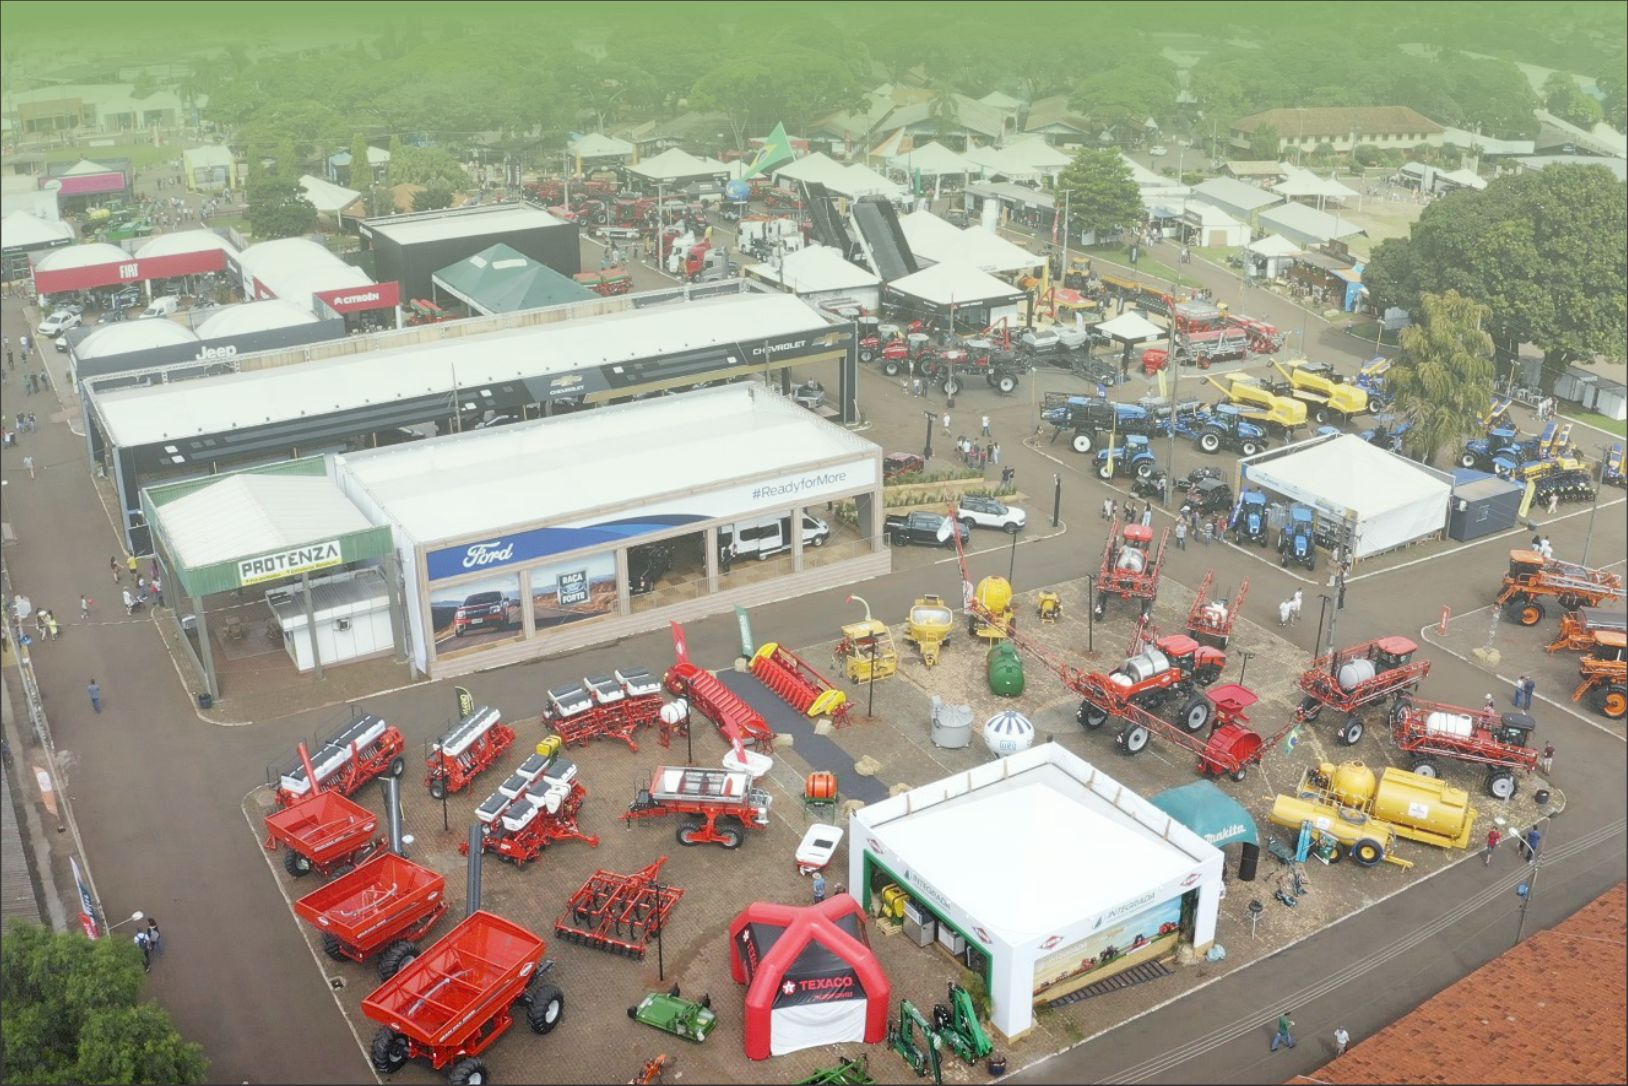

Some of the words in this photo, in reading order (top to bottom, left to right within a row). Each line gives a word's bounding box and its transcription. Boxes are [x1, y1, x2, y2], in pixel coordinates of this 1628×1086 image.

[119, 262, 138, 279] FIAT
[343, 292, 380, 304] CITROËN
[195, 344, 237, 360] Jeep
[752, 472, 847, 500] #ReadyforMore
[241, 544, 338, 577] PROTENZA
[462, 541, 514, 568] Ford
[562, 591, 585, 604] FORTE
[800, 976, 854, 991] TEXACO
